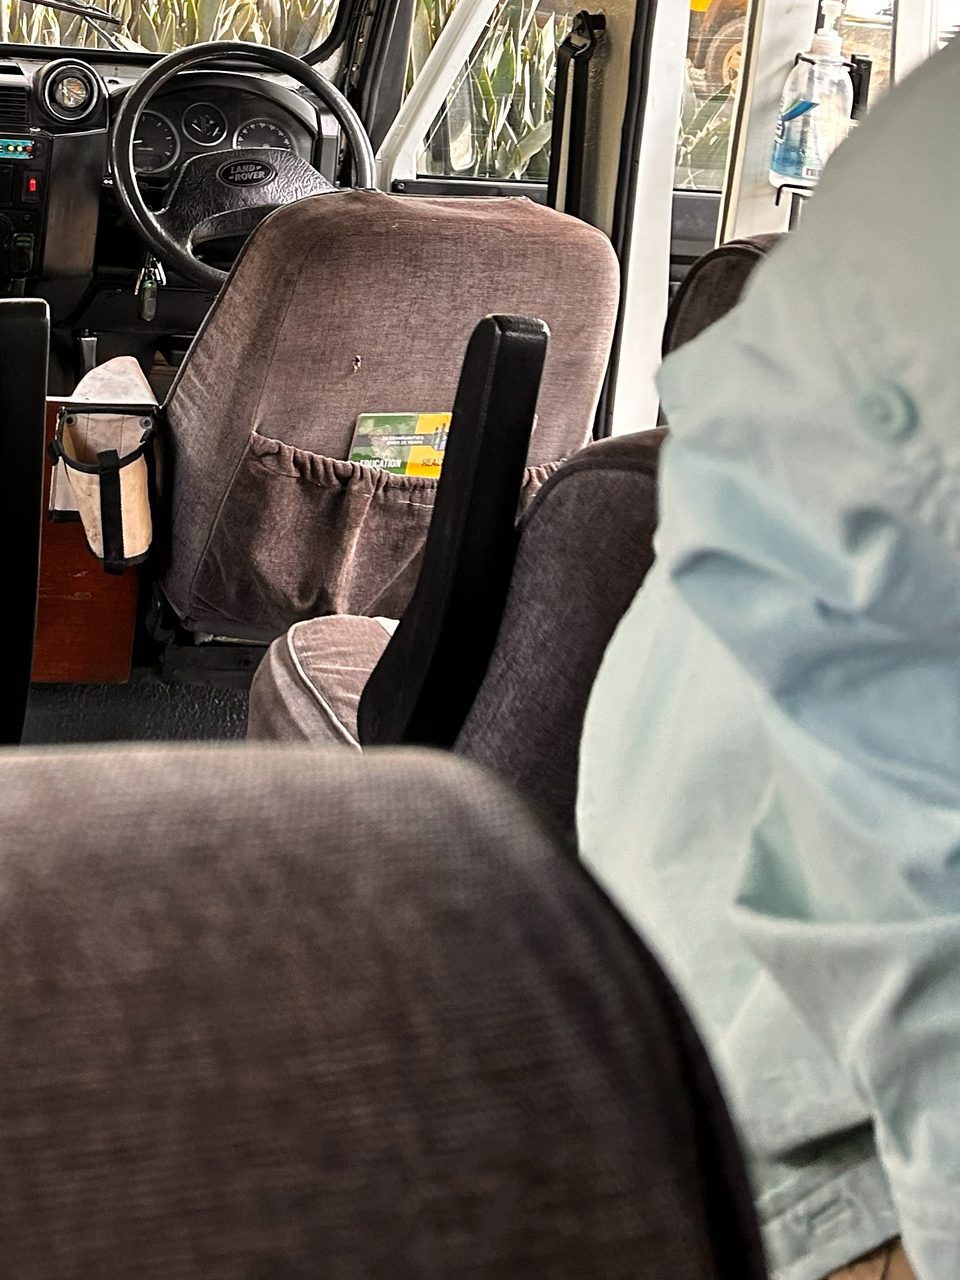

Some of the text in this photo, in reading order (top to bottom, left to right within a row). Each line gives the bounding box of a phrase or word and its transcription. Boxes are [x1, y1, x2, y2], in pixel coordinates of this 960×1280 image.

[230, 164, 256, 174] LAND
[234, 171, 265, 181] ROVER
[359, 458, 402, 468] EDUCATION
[421, 458, 443, 467] HEAL
